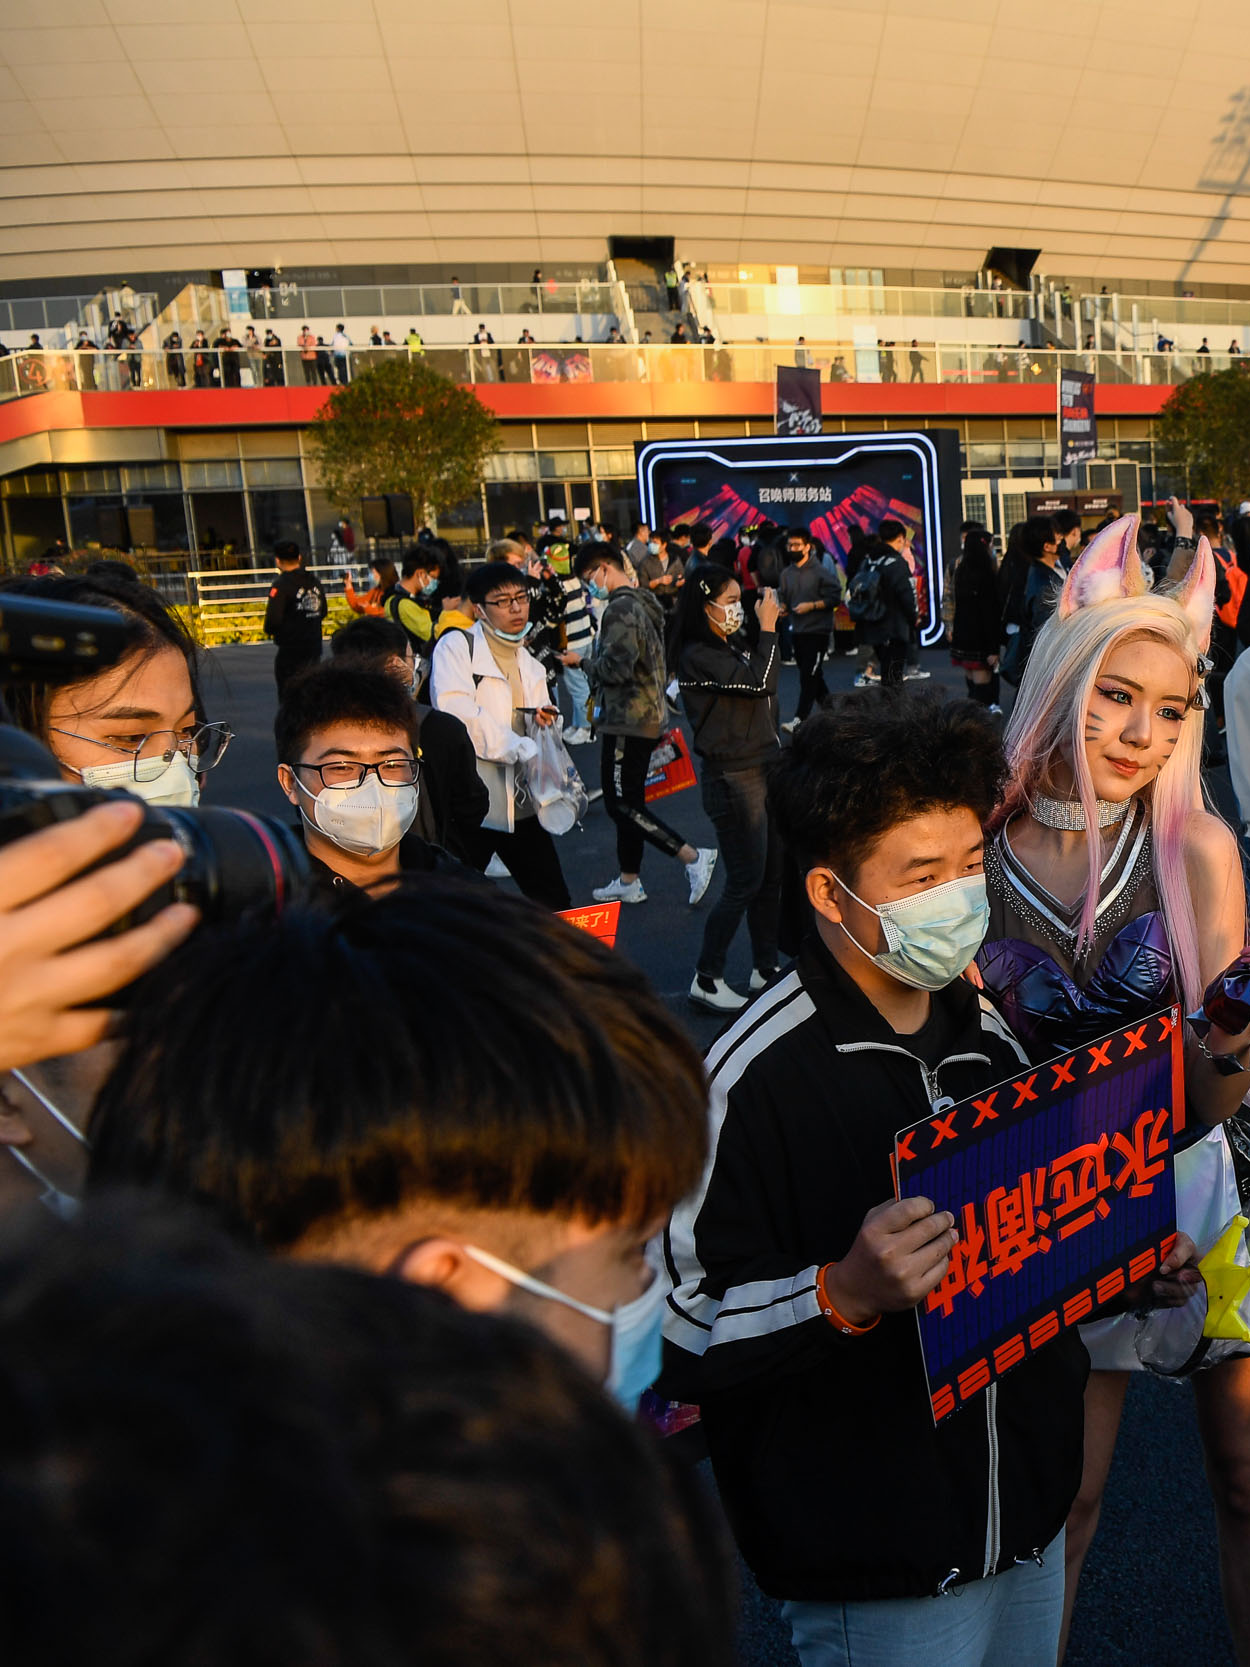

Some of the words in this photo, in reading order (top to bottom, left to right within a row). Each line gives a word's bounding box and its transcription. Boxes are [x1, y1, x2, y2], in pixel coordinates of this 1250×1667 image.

[759, 486, 832, 503] 召唤师服务站
